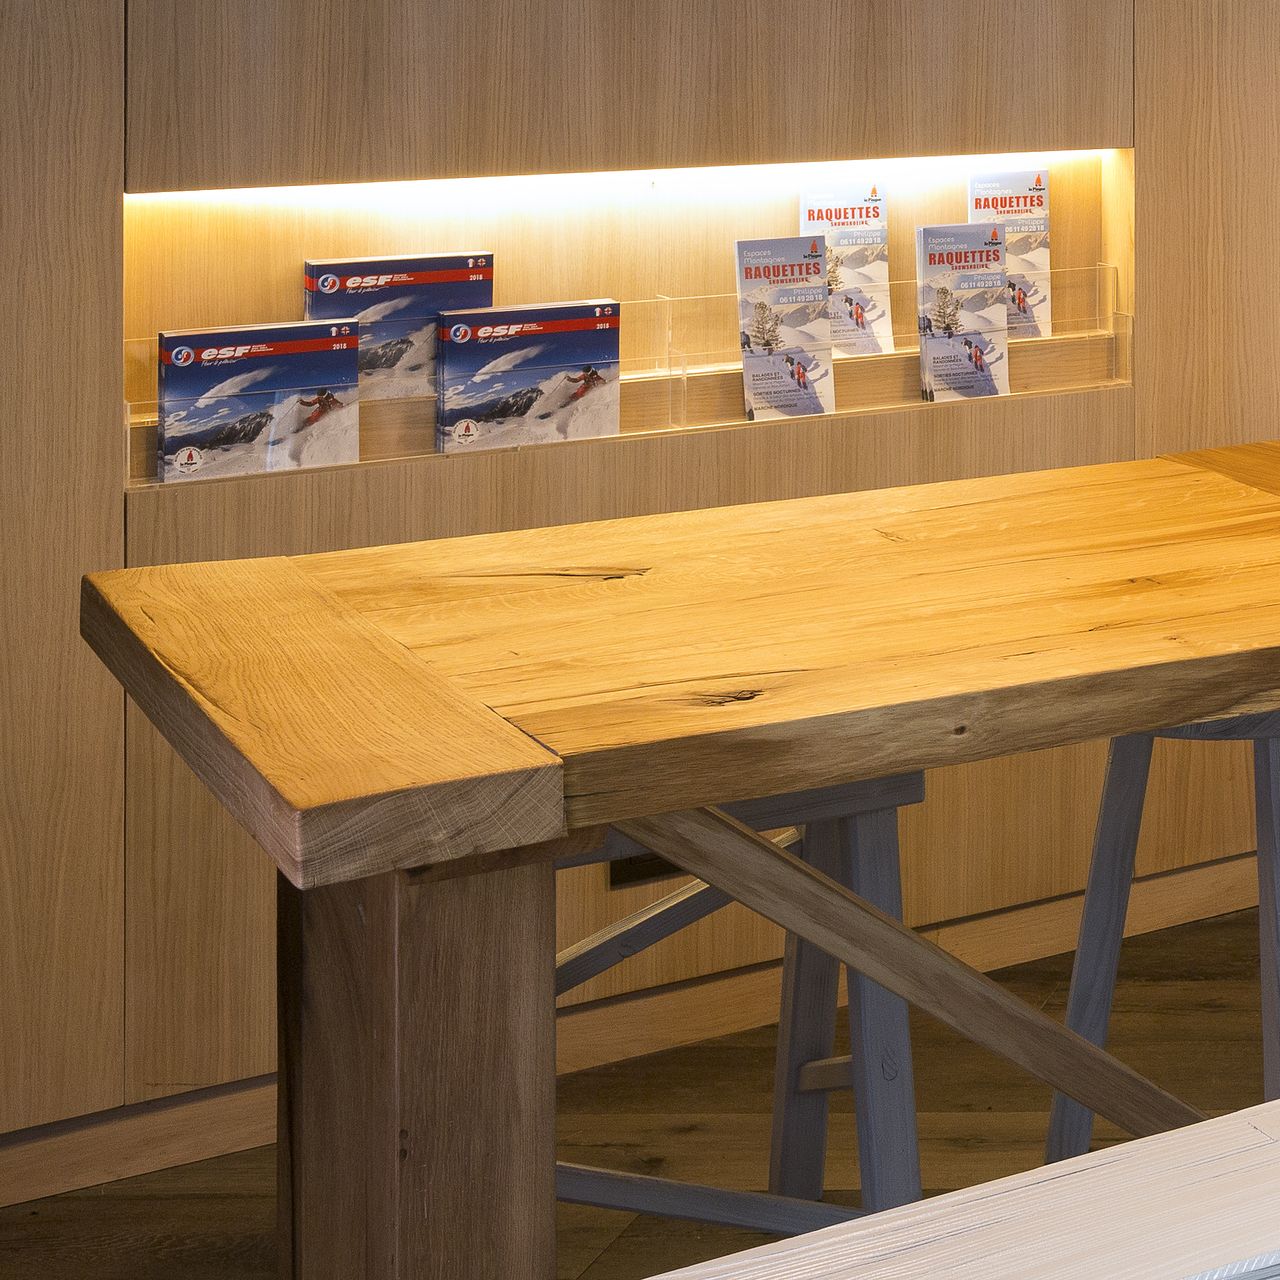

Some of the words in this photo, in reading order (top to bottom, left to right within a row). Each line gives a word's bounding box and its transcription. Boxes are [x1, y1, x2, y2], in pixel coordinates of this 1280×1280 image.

[975, 195, 1043, 209] RAQUETTES
[808, 206, 880, 221] RAQUETTES
[928, 249, 1000, 265] RAQUETTES
[744, 262, 820, 280] RAQUETTES
